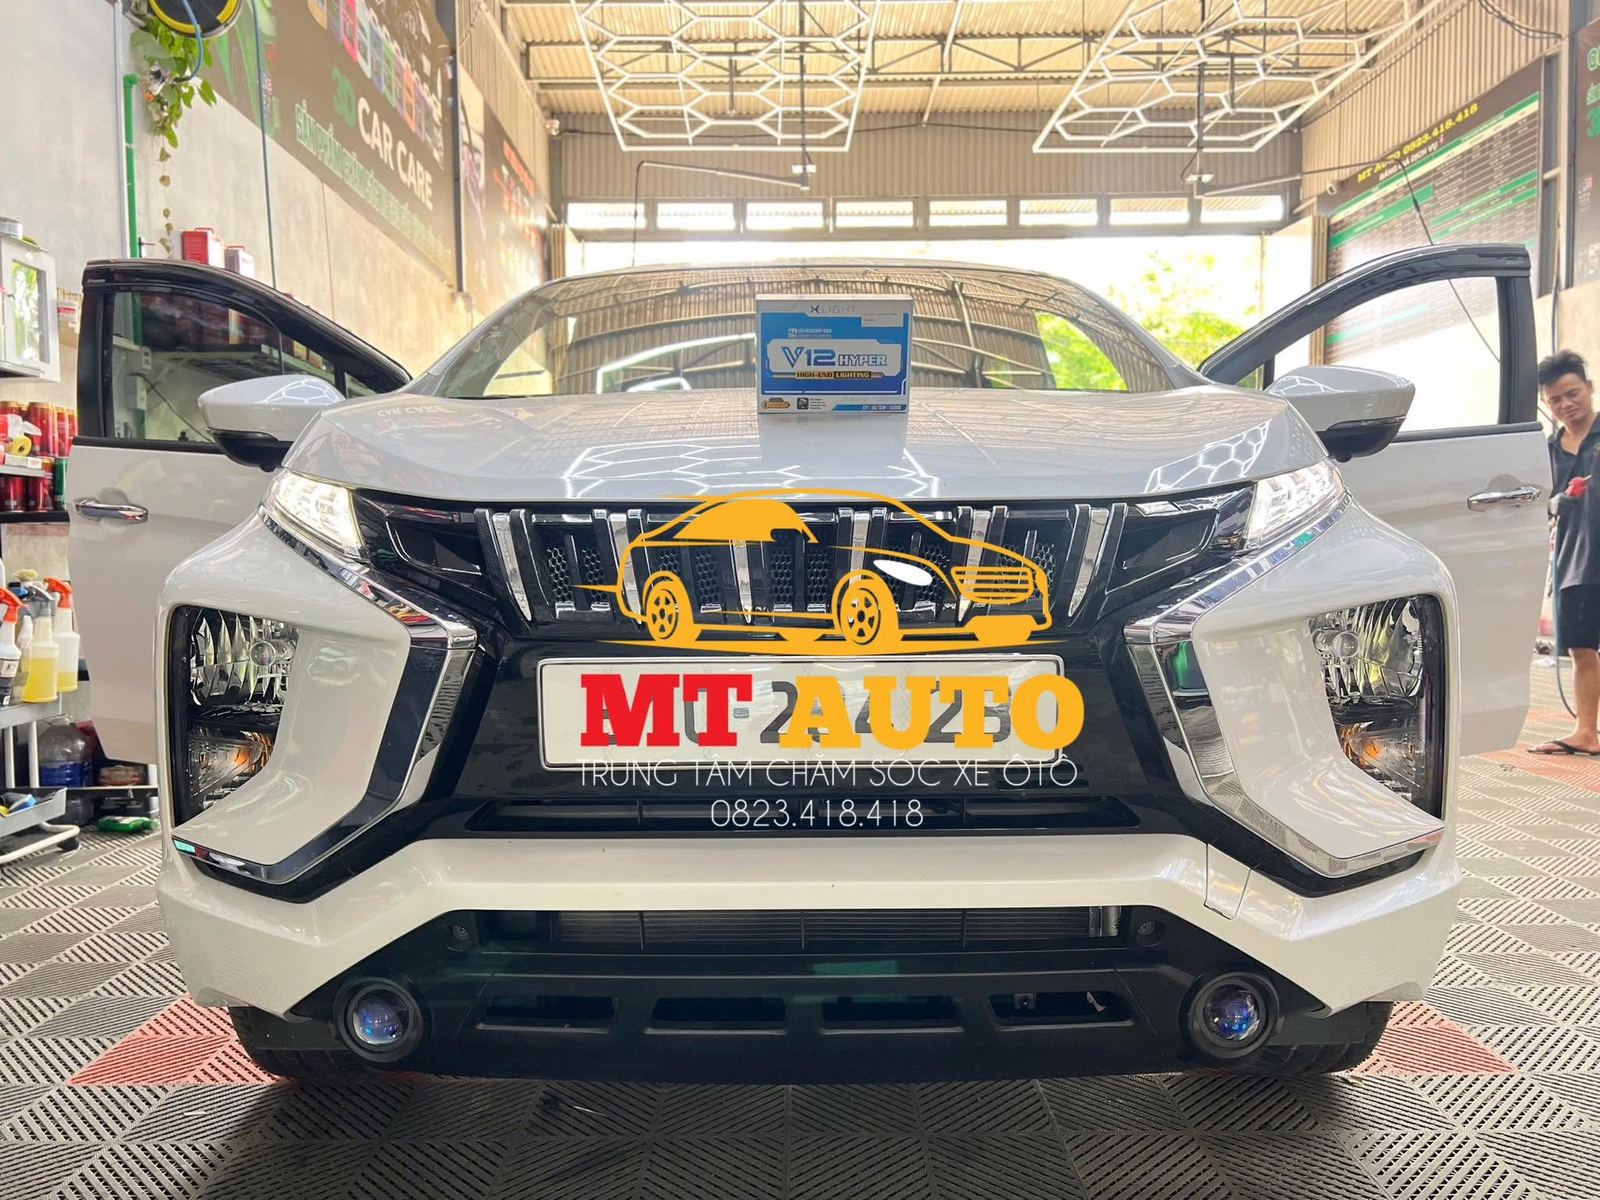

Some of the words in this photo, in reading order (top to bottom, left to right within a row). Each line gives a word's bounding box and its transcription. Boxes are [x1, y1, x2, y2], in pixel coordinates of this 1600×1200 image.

[357, 96, 395, 171] CAR
[396, 140, 433, 212] CARE
[781, 346, 836, 368] V12
[837, 354, 888, 367] HYPER
[796, 371, 833, 379] HIGH-END
[834, 371, 871, 379] LIGHTING
